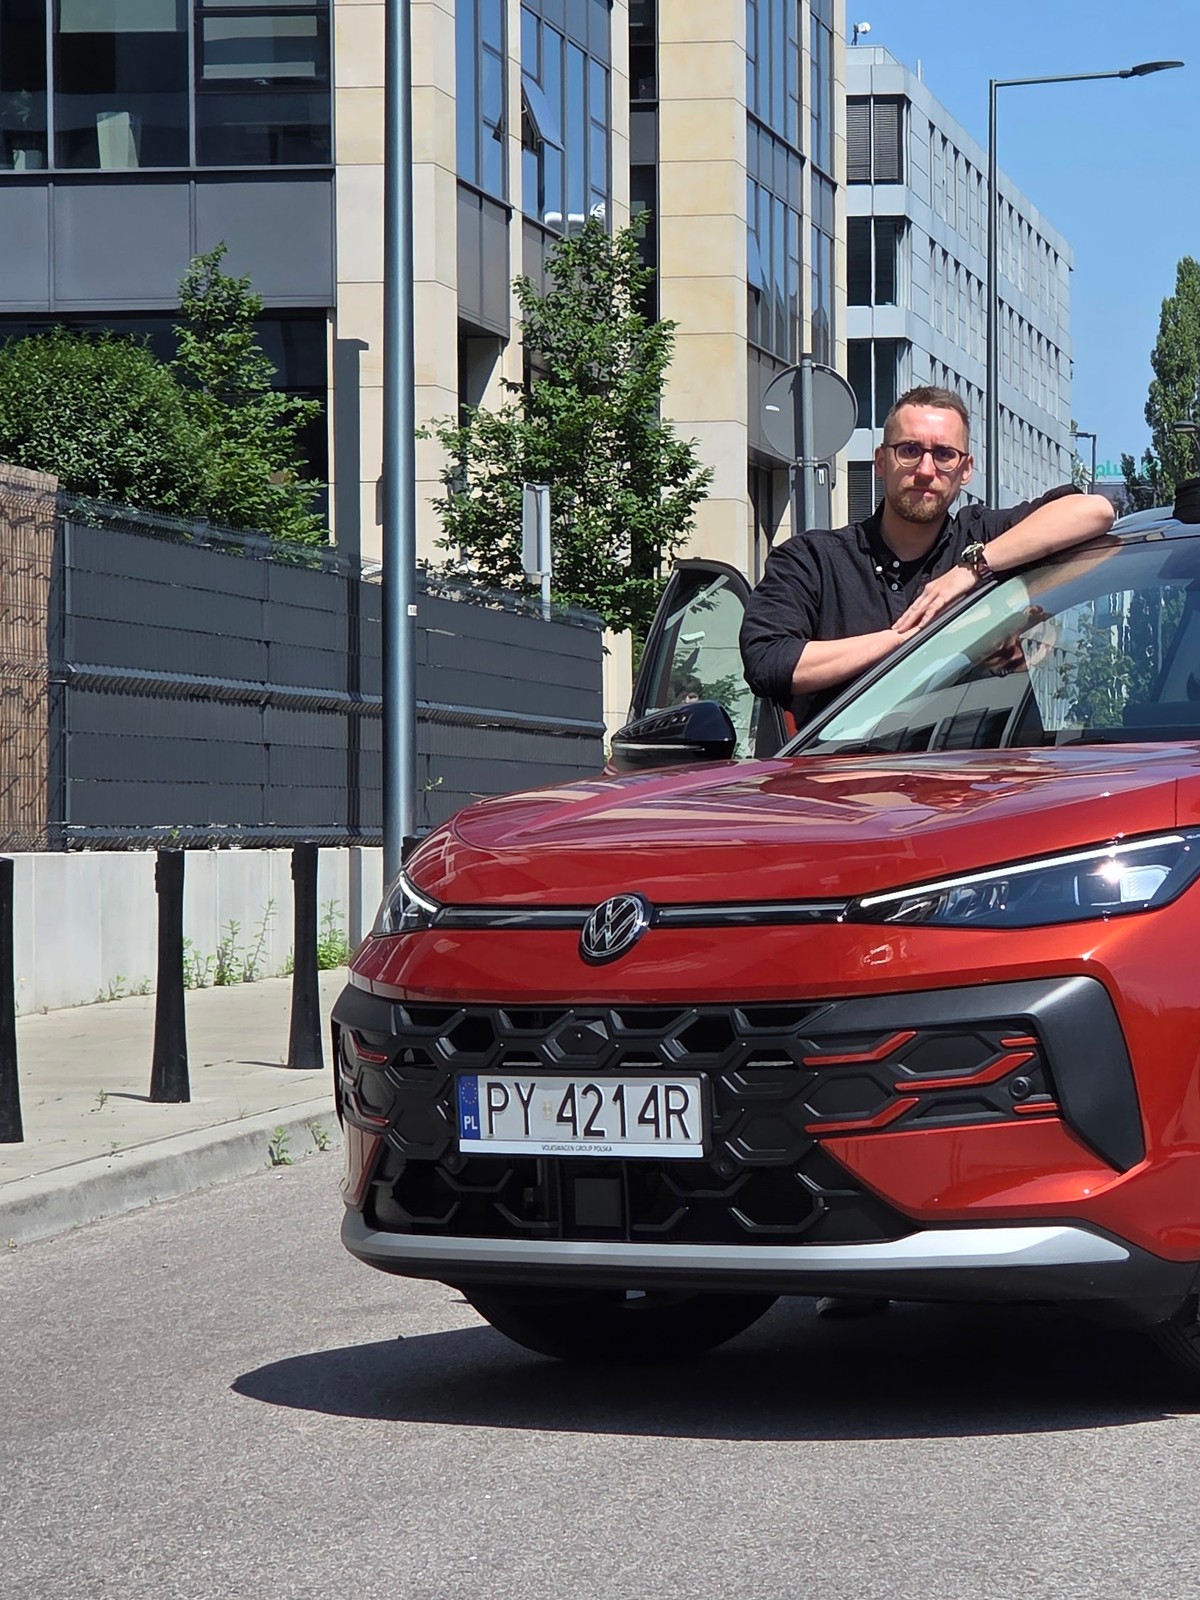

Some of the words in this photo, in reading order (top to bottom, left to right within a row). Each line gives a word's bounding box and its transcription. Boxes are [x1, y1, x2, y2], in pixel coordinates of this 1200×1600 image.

[582, 895, 644, 957] VW
[463, 1115, 478, 1130] PL
[486, 1082, 536, 1137] PY
[556, 1083, 691, 1140] 4214R
